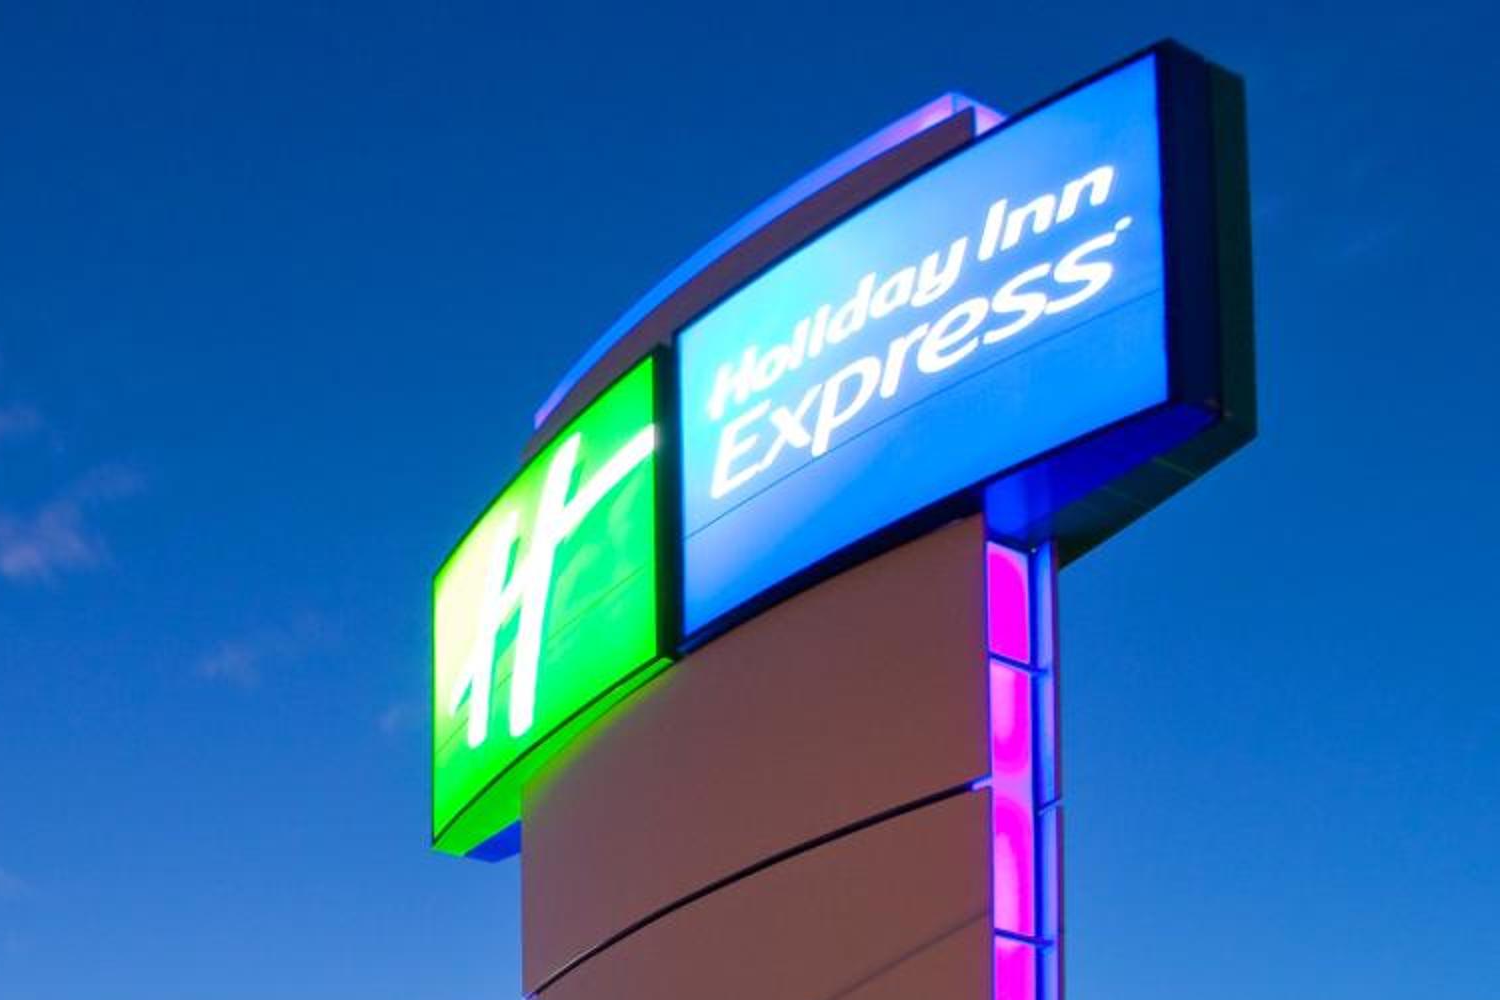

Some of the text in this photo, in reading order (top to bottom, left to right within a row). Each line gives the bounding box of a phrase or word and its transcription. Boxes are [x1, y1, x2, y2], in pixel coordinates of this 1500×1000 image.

[708, 164, 1115, 421] Holiday Inn
[710, 229, 1118, 499] Express
